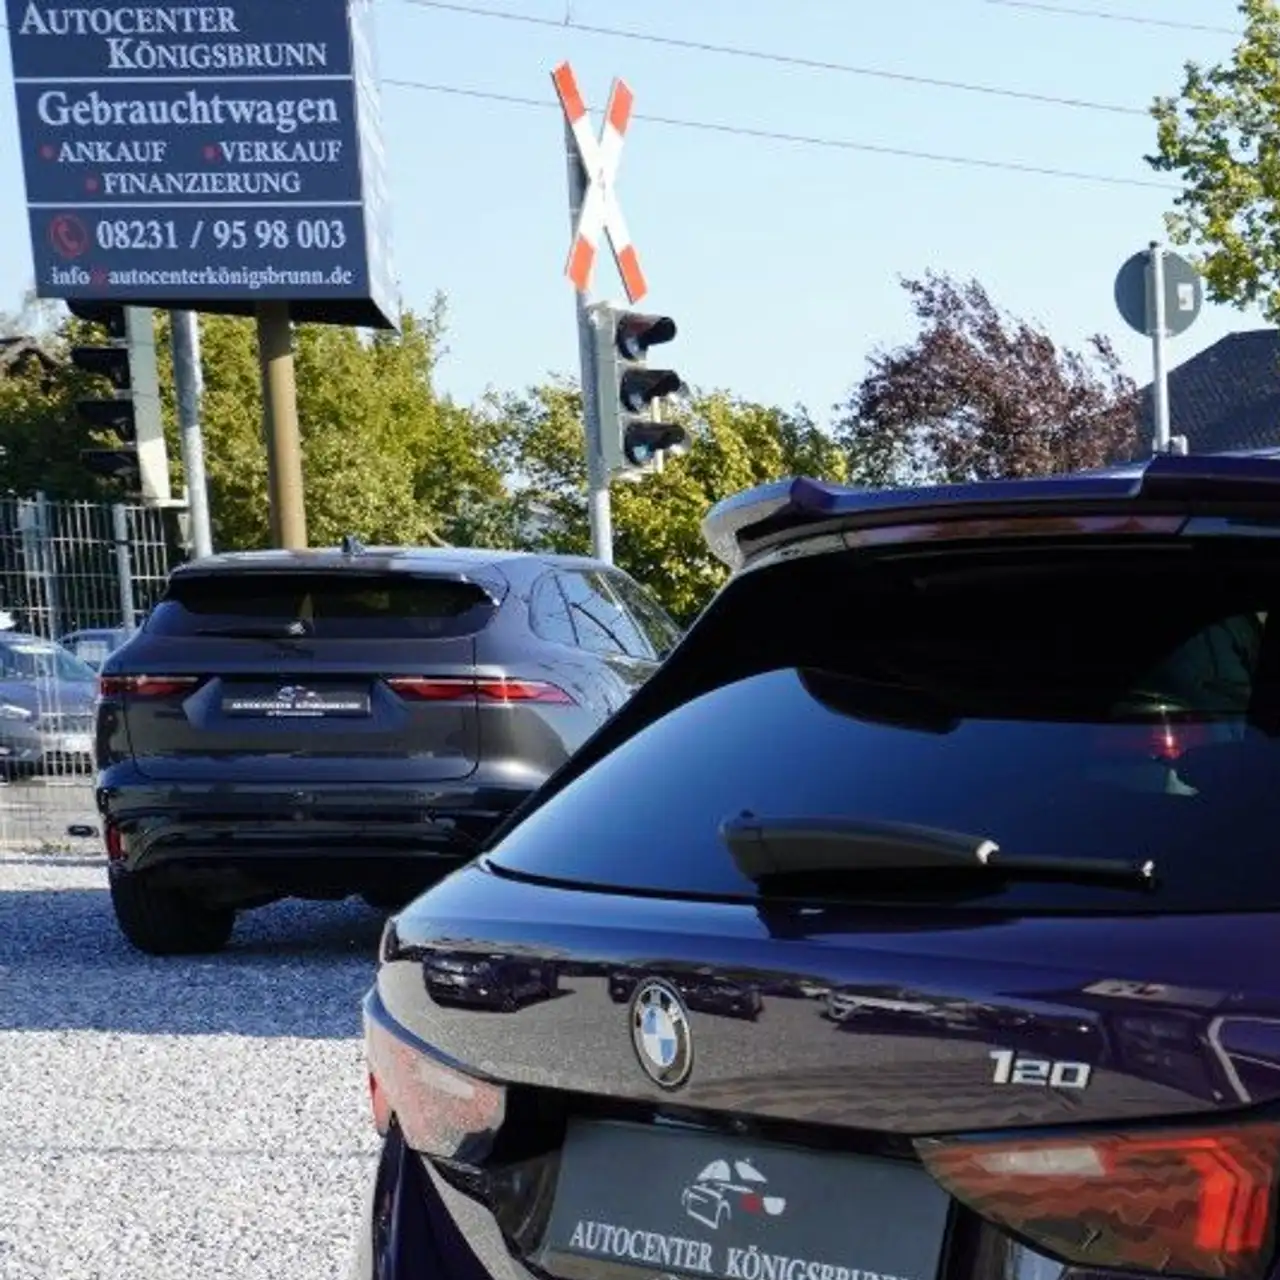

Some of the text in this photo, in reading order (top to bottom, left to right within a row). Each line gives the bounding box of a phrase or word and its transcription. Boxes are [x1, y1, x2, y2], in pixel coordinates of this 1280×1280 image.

[19, 3, 241, 36] AUTOCENTER
[106, 37, 328, 70] KÖNIGSBRUNN
[37, 90, 339, 133] Gebrauchtwagen
[57, 140, 343, 164] ANKAUF VERKAUF
[103, 172, 301, 195] FINANZIERUNG
[97, 220, 347, 250] 08231 / 95 98 003
[989, 1050, 1092, 1090] 120
[569, 1221, 714, 1273] AUTOCENTER
